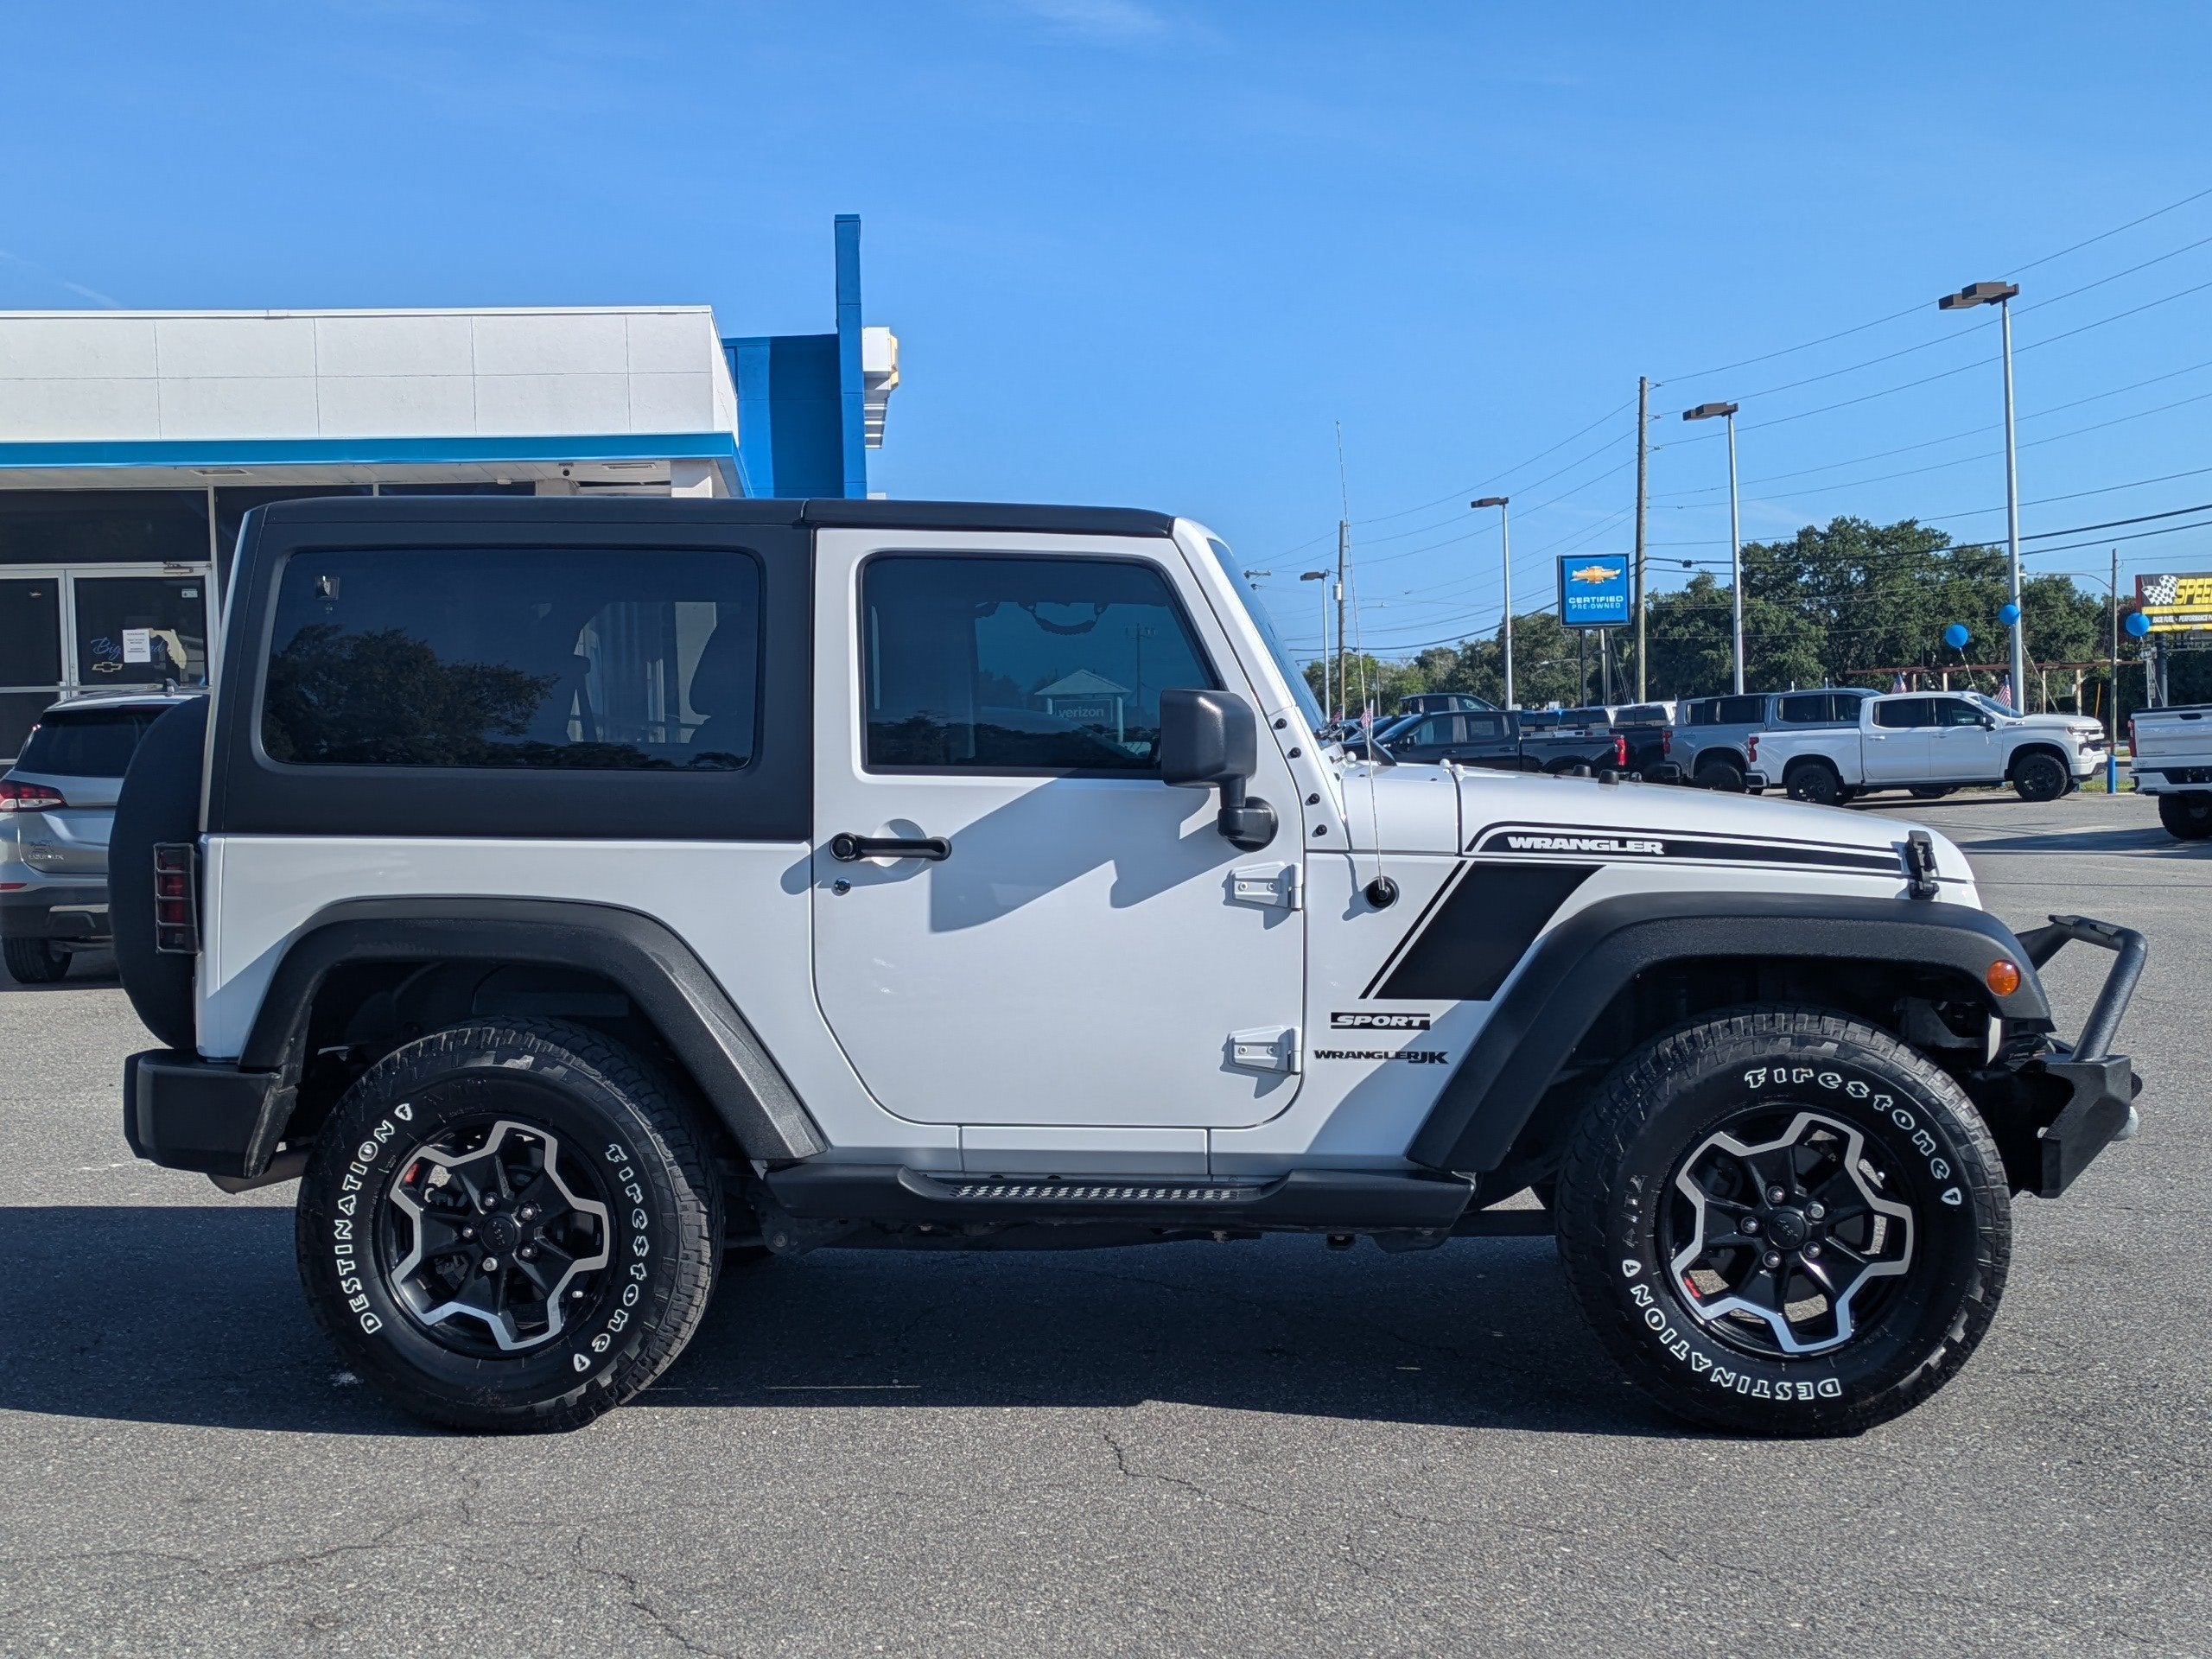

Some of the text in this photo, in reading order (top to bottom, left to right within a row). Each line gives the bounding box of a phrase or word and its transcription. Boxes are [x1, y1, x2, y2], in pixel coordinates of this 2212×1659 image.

[1568, 595, 1624, 604] CERTIFIED
[2174, 578, 2212, 604] SPEE
[90, 637, 122, 660] Big
[1058, 707, 1104, 718] verizon
[1507, 836, 1664, 855] WRANGLER
[1337, 1015, 1430, 1027] SPORT
[1745, 1066, 1952, 1181] Firestone
[333, 1120, 397, 1335] DESTINATION
[592, 1143, 650, 1354] Firestone
[1630, 1282, 1841, 1401] DESTINATION
